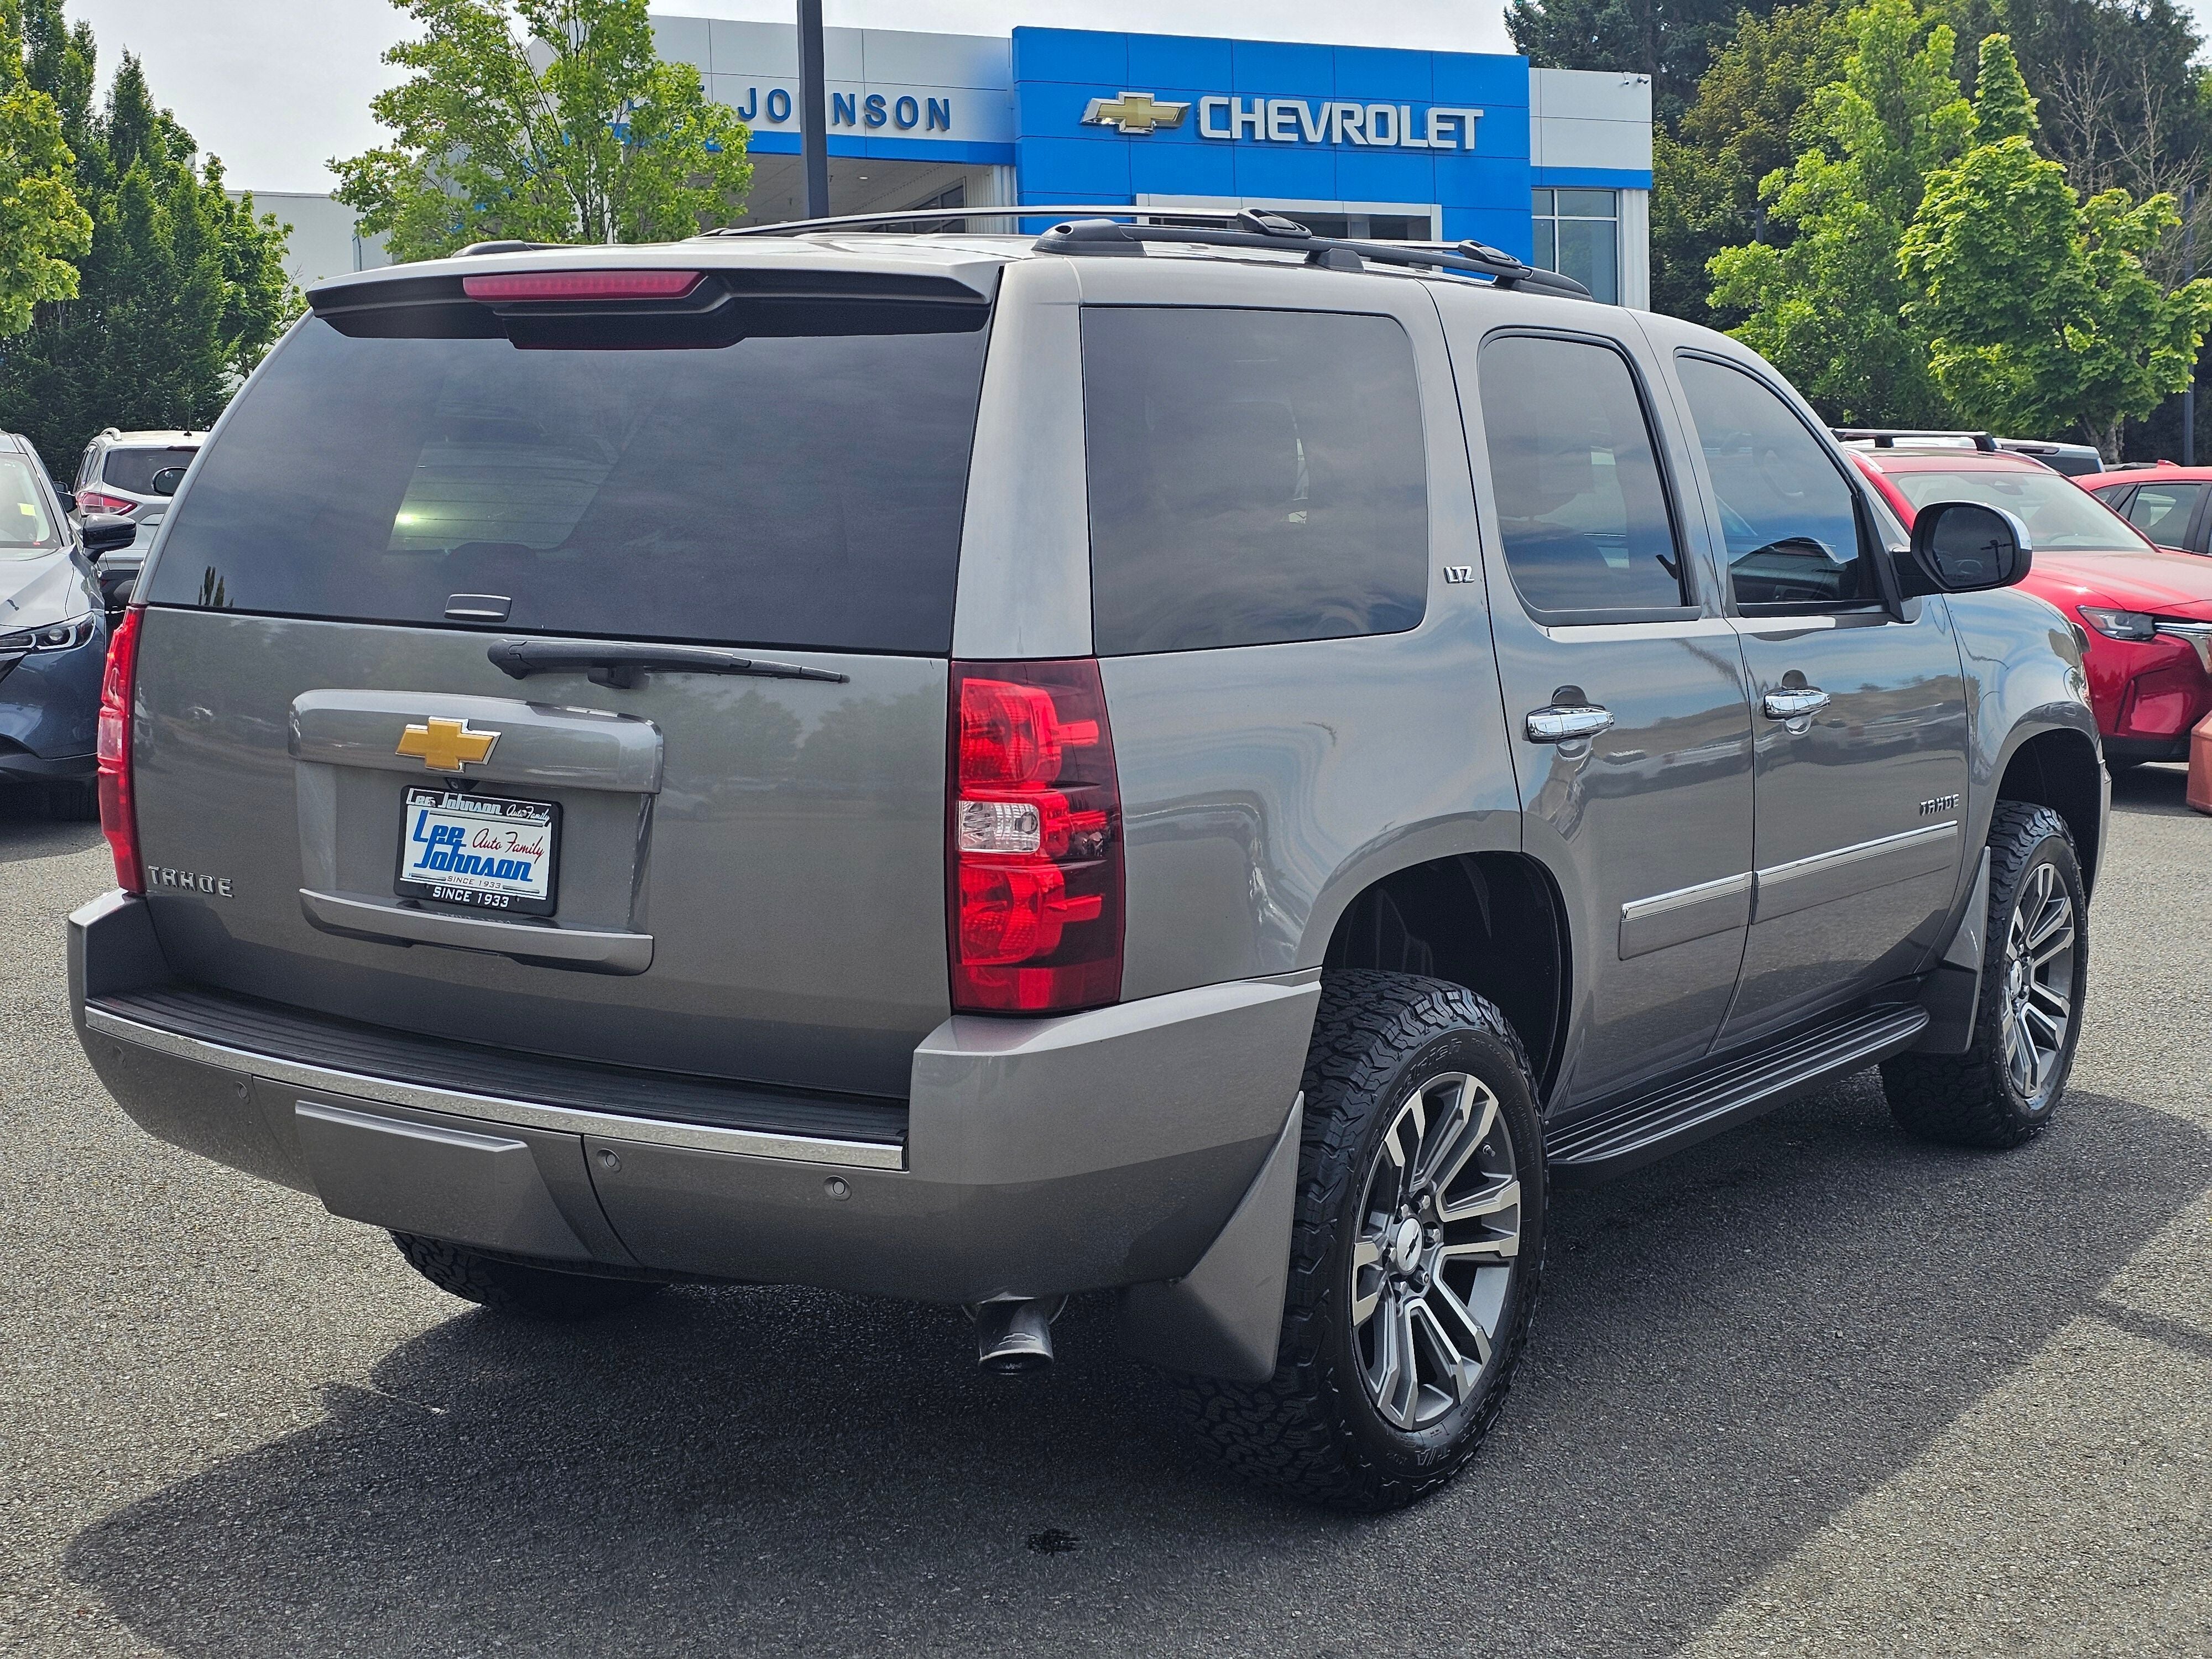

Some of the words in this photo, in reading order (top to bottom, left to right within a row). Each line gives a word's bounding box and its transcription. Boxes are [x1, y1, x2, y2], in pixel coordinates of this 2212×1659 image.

[738, 87, 951, 131] JONSON
[1199, 96, 1484, 150] CHEVROLET
[1443, 566, 1475, 584] LTZ
[406, 787, 436, 807] Lee
[437, 791, 503, 815] Johnson
[506, 804, 524, 817] Aut
[1919, 794, 1959, 817] TAHOE
[413, 810, 466, 847] Lee
[413, 839, 533, 882] Johnson
[472, 828, 502, 851] Auto
[504, 831, 545, 864] Family
[148, 865, 234, 898] TAHOE
[432, 886, 472, 902] SINCE
[477, 893, 509, 907] 1933
[447, 875, 475, 885] SINCE
[479, 880, 501, 889] 1933
